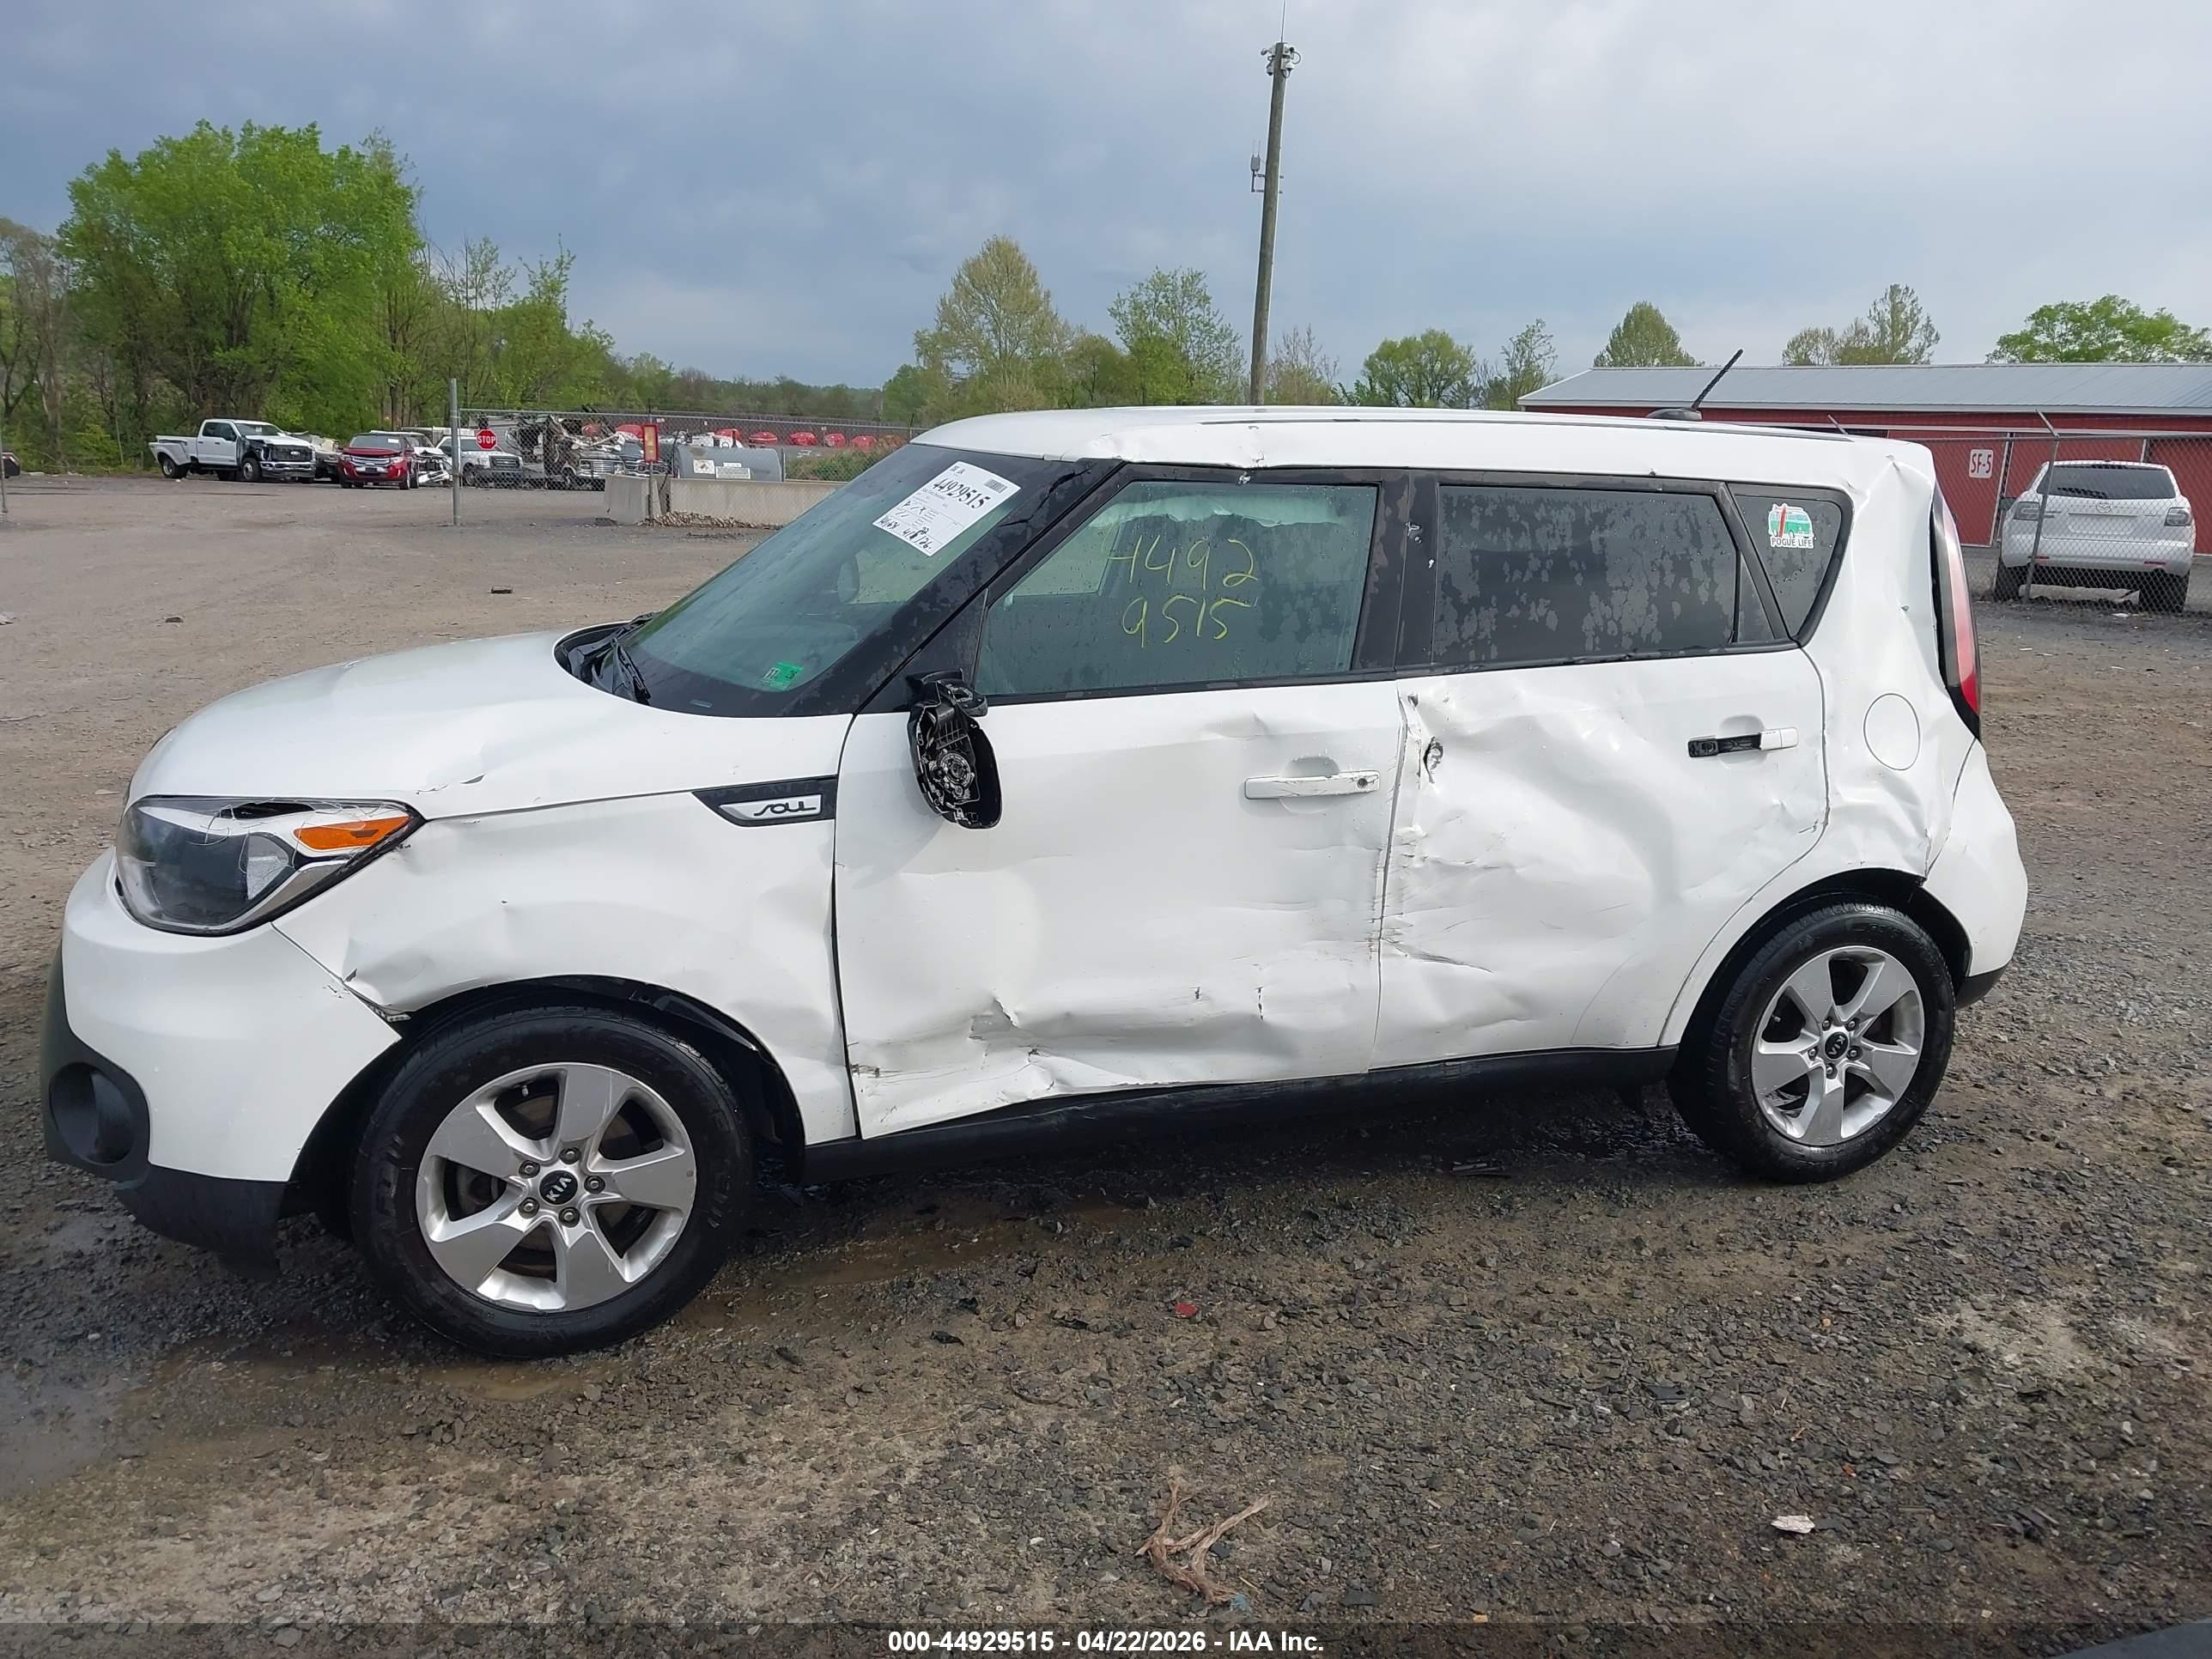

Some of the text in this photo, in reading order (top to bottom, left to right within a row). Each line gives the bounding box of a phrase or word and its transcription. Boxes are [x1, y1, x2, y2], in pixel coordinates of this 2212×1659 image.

[477, 435, 495, 444] STOP
[1971, 453, 1992, 473] SF-5
[933, 477, 991, 509] 44929515
[1771, 538, 1813, 548] POGUE LIFE
[1104, 532, 1258, 591] 4492
[1121, 597, 1253, 648] 9515
[753, 800, 817, 817] SOUL
